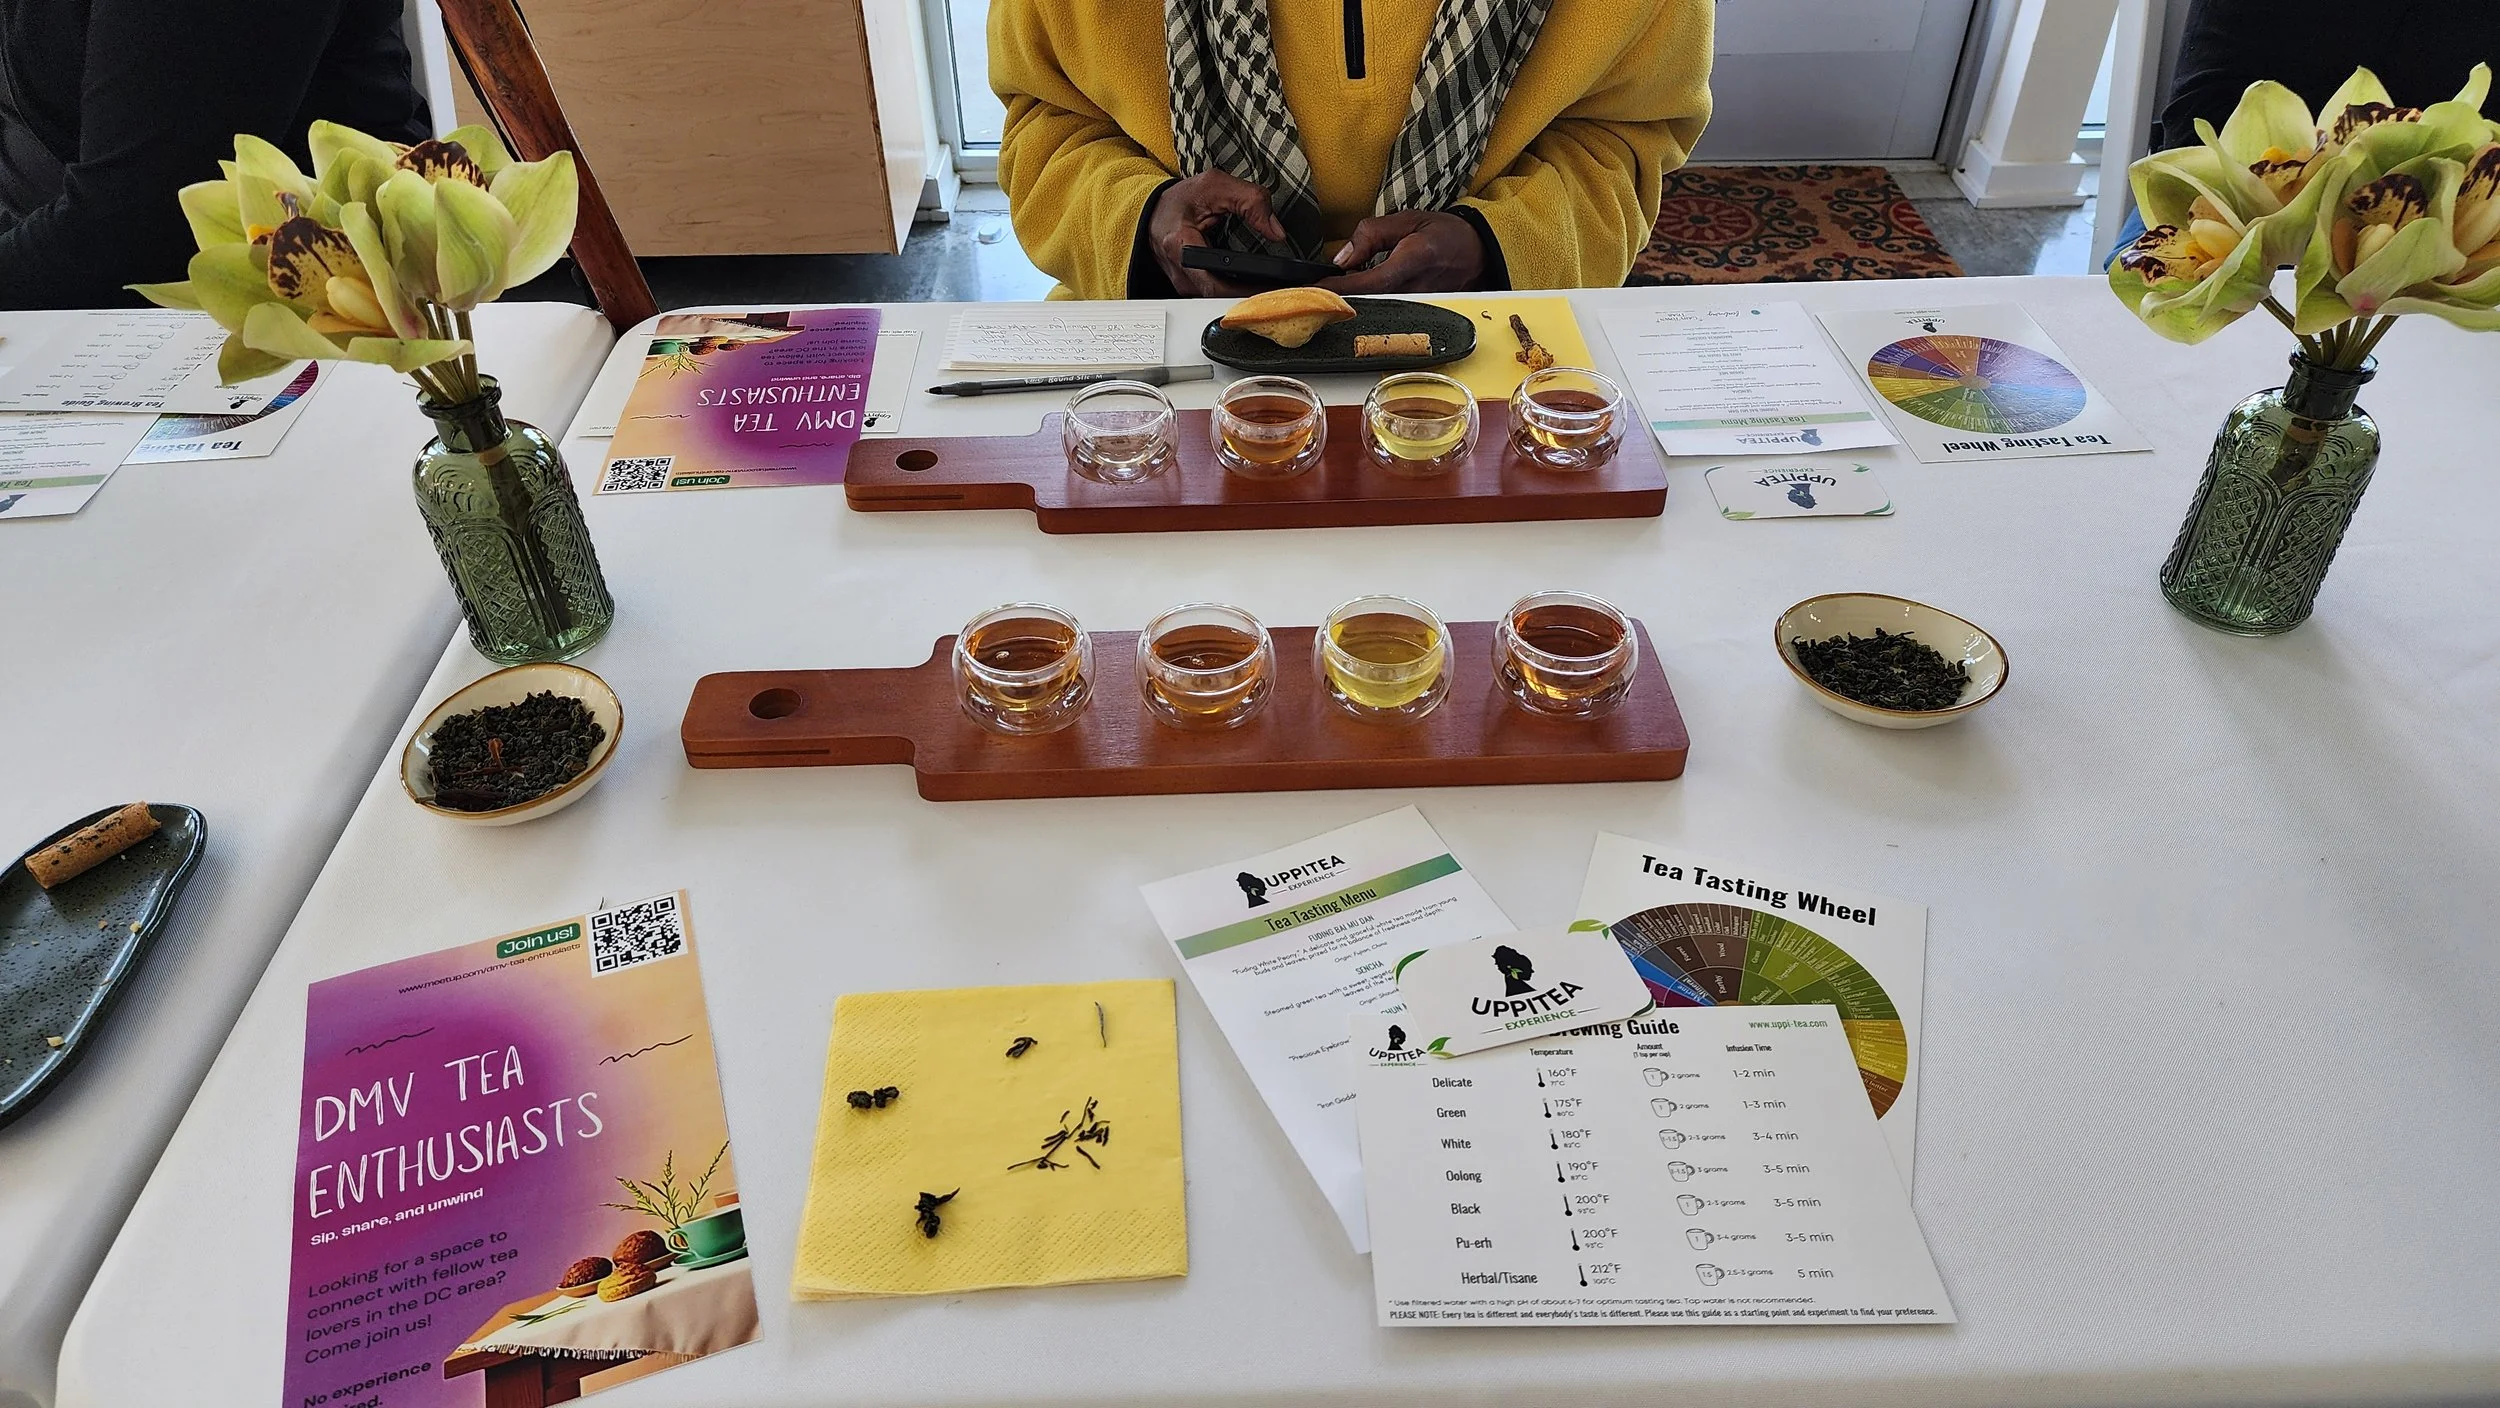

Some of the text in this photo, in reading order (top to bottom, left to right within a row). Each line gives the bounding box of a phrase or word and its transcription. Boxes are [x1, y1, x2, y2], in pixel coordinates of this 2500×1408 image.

[696, 383, 861, 407] ENTHUSIASTS
[97, 400, 143, 409] Brewing
[145, 401, 165, 409] Tea
[734, 410, 855, 433] DMV TEA
[1720, 411, 1807, 426] Tea Tasting Menu
[212, 440, 243, 451] Tea
[1735, 435, 1802, 445] UPPITEA
[1942, 434, 2112, 453] Tea Tasting Wheel
[676, 478, 696, 486] us!
[1753, 473, 1838, 487] UPPITEA
[1264, 855, 1346, 887] UPPITEA
[1288, 871, 1336, 891] EXPERIENCE
[1640, 854, 1877, 926] Tea Tasting Wheel
[1264, 888, 1377, 932] Tea Tasting Menu
[1257, 959, 1277, 967] White
[1308, 940, 1334, 951] delicate
[1335, 934, 1348, 943] and
[1348, 925, 1374, 939] graceful
[1376, 919, 1392, 928] white
[1404, 909, 1422, 917] made
[1421, 903, 1438, 911] from
[1438, 896, 1457, 907] young
[1308, 915, 1375, 942] FUDING BAI MU DAN
[502, 926, 575, 954] Join us!
[398, 943, 581, 995] www.meetup.com/dmv-tea-enthusiasts
[1355, 960, 1385, 975] SENCHA
[1471, 978, 1585, 1020] UPPITEA
[1504, 1009, 1578, 1031] EXPERIENCE
[1748, 1019, 1828, 1029] www.uppi-tea.com
[1627, 1019, 1680, 1035] Guide
[1636, 1042, 1663, 1050] Amount
[1726, 1044, 1772, 1052] Infusion Time
[1368, 1047, 1426, 1062] UPPITEA
[1530, 1048, 1574, 1057] Temperature
[1548, 1067, 1577, 1077] 160°F
[1733, 1069, 1776, 1078] 1-2 min
[1432, 1077, 1473, 1088] Delicate
[315, 1045, 525, 1143] DMV TEA
[1554, 1098, 1583, 1108] 175°F
[1743, 1100, 1787, 1109] 1-3 min
[1436, 1107, 1467, 1118] Green
[1561, 1129, 1592, 1139] 180°F
[1752, 1132, 1799, 1141] 3-4 min
[1441, 1138, 1472, 1149] White
[309, 1091, 604, 1219] ENTHUSIASTS
[1567, 1161, 1599, 1171] 190°F
[1763, 1164, 1810, 1173] 3-5 min
[1446, 1170, 1482, 1183] Oolong
[1575, 1194, 1610, 1204] 200°F
[1774, 1198, 1822, 1207] 3-5 min
[1451, 1203, 1481, 1214] Black
[310, 1187, 484, 1246] Sip, share, and unwind
[1582, 1228, 1618, 1238] 200°F
[1785, 1232, 1834, 1242] 3-5 min
[1456, 1237, 1492, 1249] Pu-erh
[308, 1231, 508, 1298] Looking for a space to
[1590, 1263, 1622, 1274] 212°F
[1461, 1271, 1538, 1285] Herbal/Tisane
[1797, 1268, 1834, 1278] 5 min
[307, 1247, 519, 1320] connect with fellow tea
[306, 1270, 507, 1342] lovers in the DC area?
[1441, 1311, 1462, 1320] Every
[1520, 1310, 1533, 1318] and
[1685, 1309, 1700, 1317] this
[1702, 1309, 1722, 1319] guide
[1740, 1309, 1770, 1319] starting
[1771, 1309, 1790, 1319] point
[1807, 1309, 1849, 1318] experiment
[1877, 1310, 1893, 1318] your
[1894, 1308, 1938, 1318] preference.
[304, 1314, 433, 1364] Come join us!
[303, 1394, 327, 1408] No
[332, 1362, 432, 1399] experience
